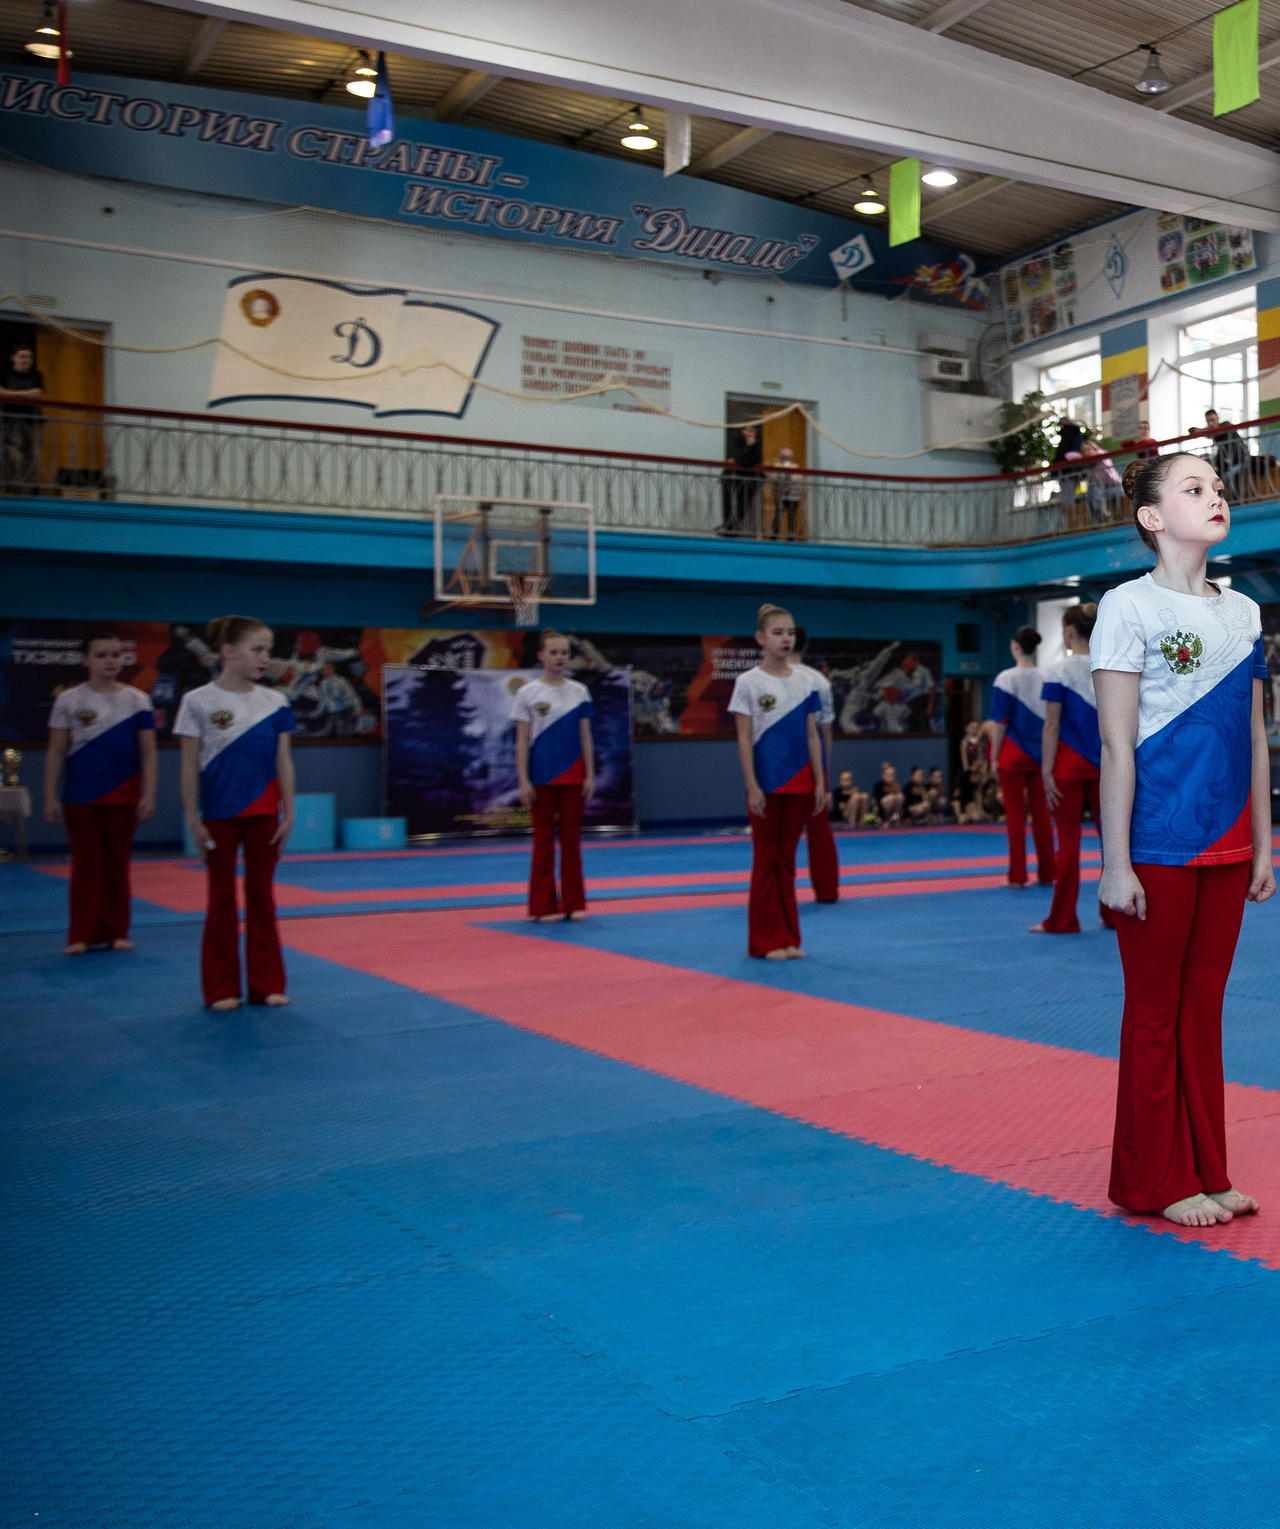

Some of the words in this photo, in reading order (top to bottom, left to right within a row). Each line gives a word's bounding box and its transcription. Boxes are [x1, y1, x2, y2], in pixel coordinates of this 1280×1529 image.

[0, 74, 283, 154] ИСТОРИЯ
[287, 125, 503, 189] СТРАНЫ
[402, 183, 624, 246] ИСТОРИЯ
[632, 203, 819, 274] "Динамо"
